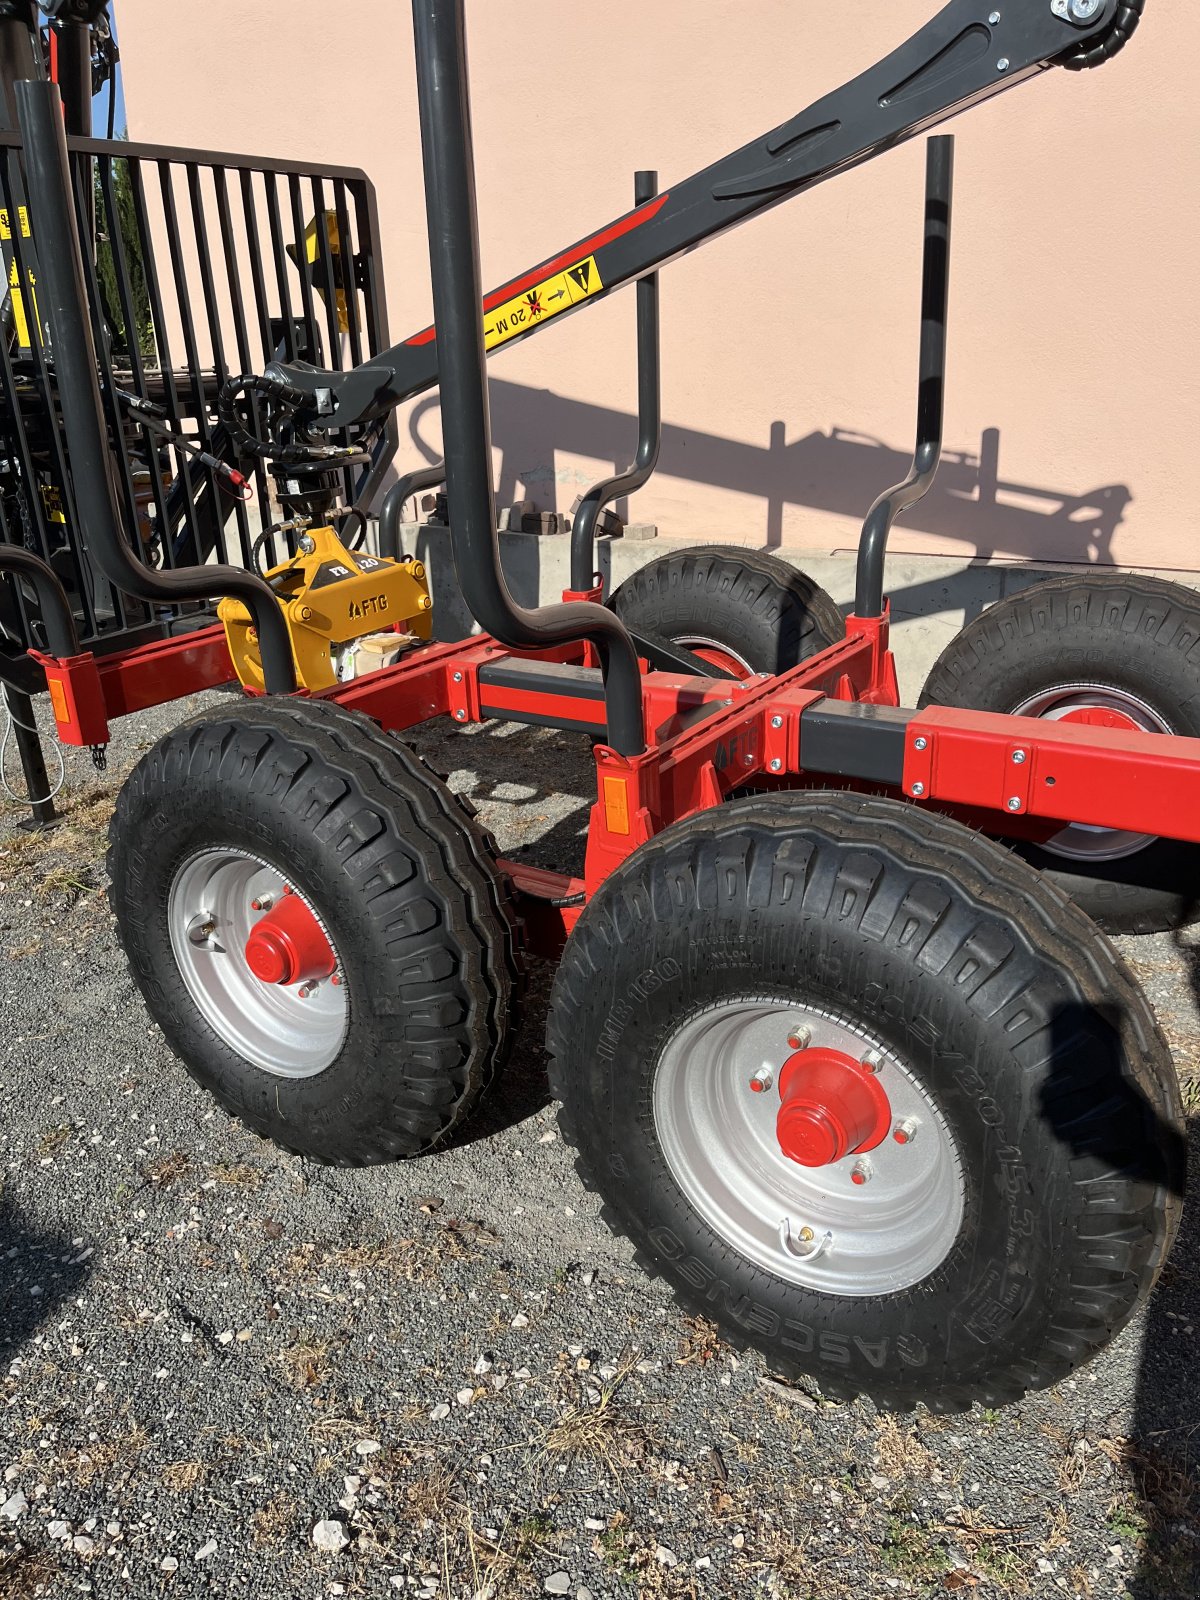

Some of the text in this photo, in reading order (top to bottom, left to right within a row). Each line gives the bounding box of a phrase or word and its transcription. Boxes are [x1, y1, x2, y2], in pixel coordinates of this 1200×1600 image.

[496, 310, 526, 335] 20 M
[329, 558, 380, 578] FB 120
[641, 603, 747, 638] SCENSO
[626, 957, 683, 1004] 160
[648, 1226, 891, 1369] ASCENSO
